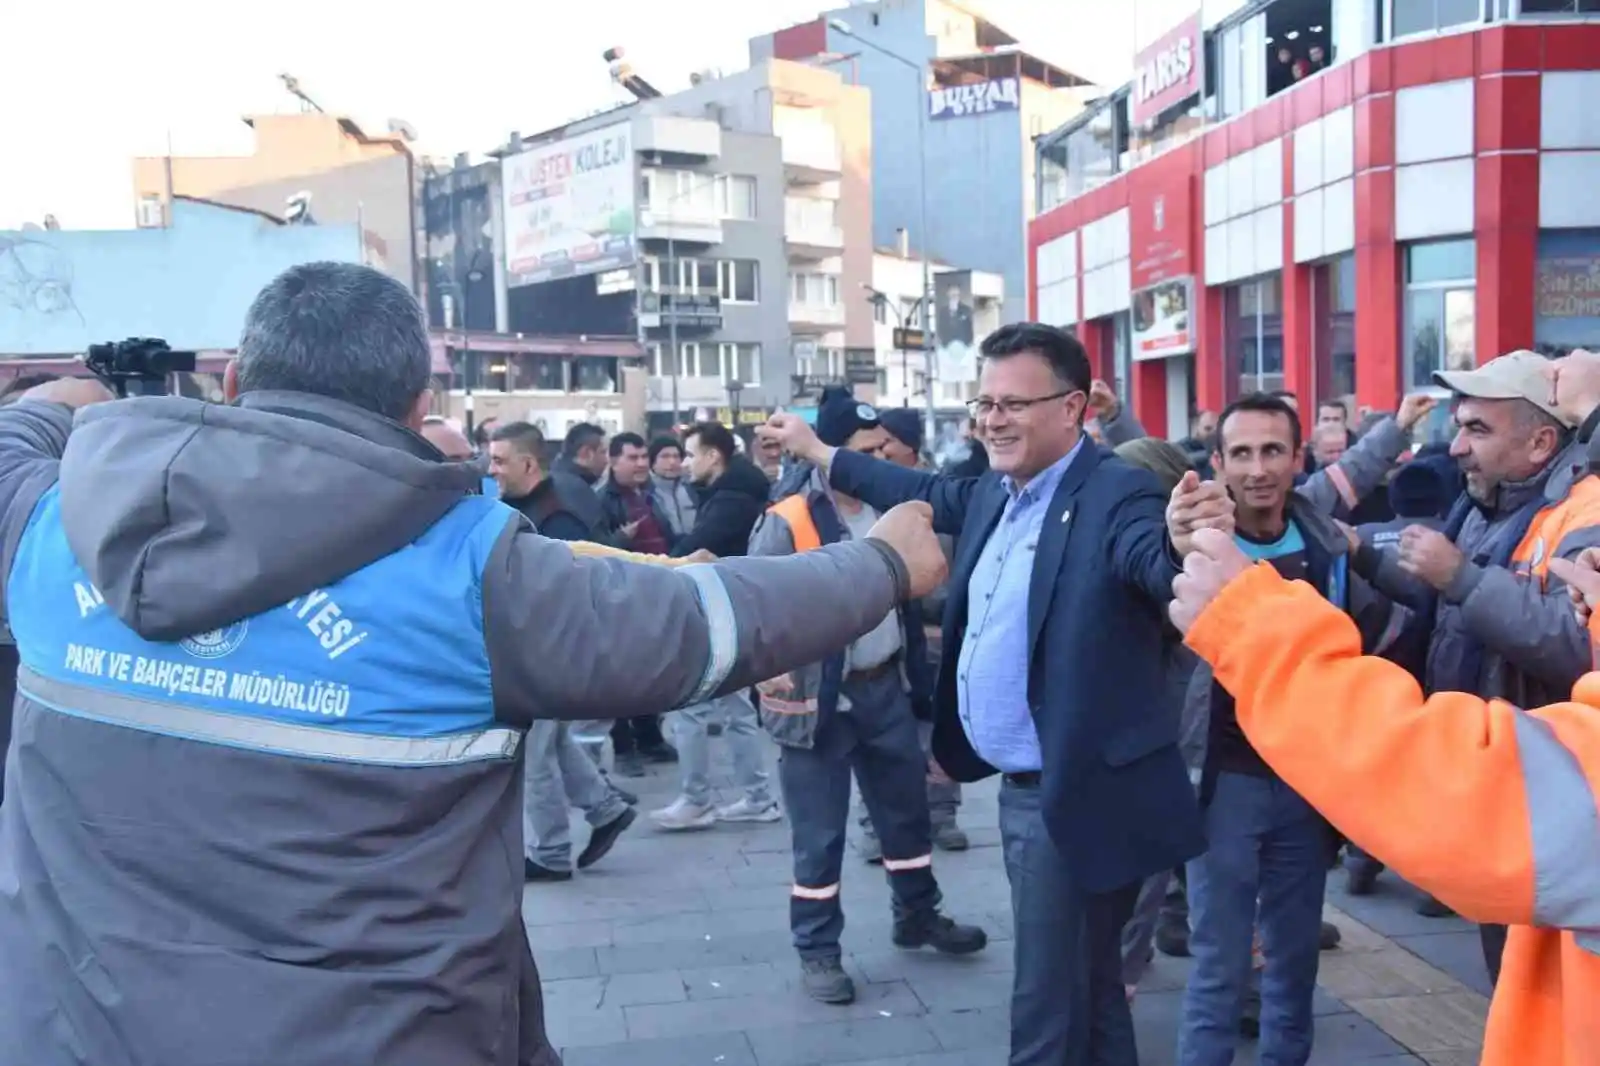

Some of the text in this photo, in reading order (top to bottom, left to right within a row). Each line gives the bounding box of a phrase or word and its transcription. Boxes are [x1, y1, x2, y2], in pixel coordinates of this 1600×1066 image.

[930, 78, 1019, 115] BULVAR
[286, 588, 368, 660] YESİ
[65, 642, 351, 717] PARK VE BAHÇELER MÜDÜRLÜĞÜ
